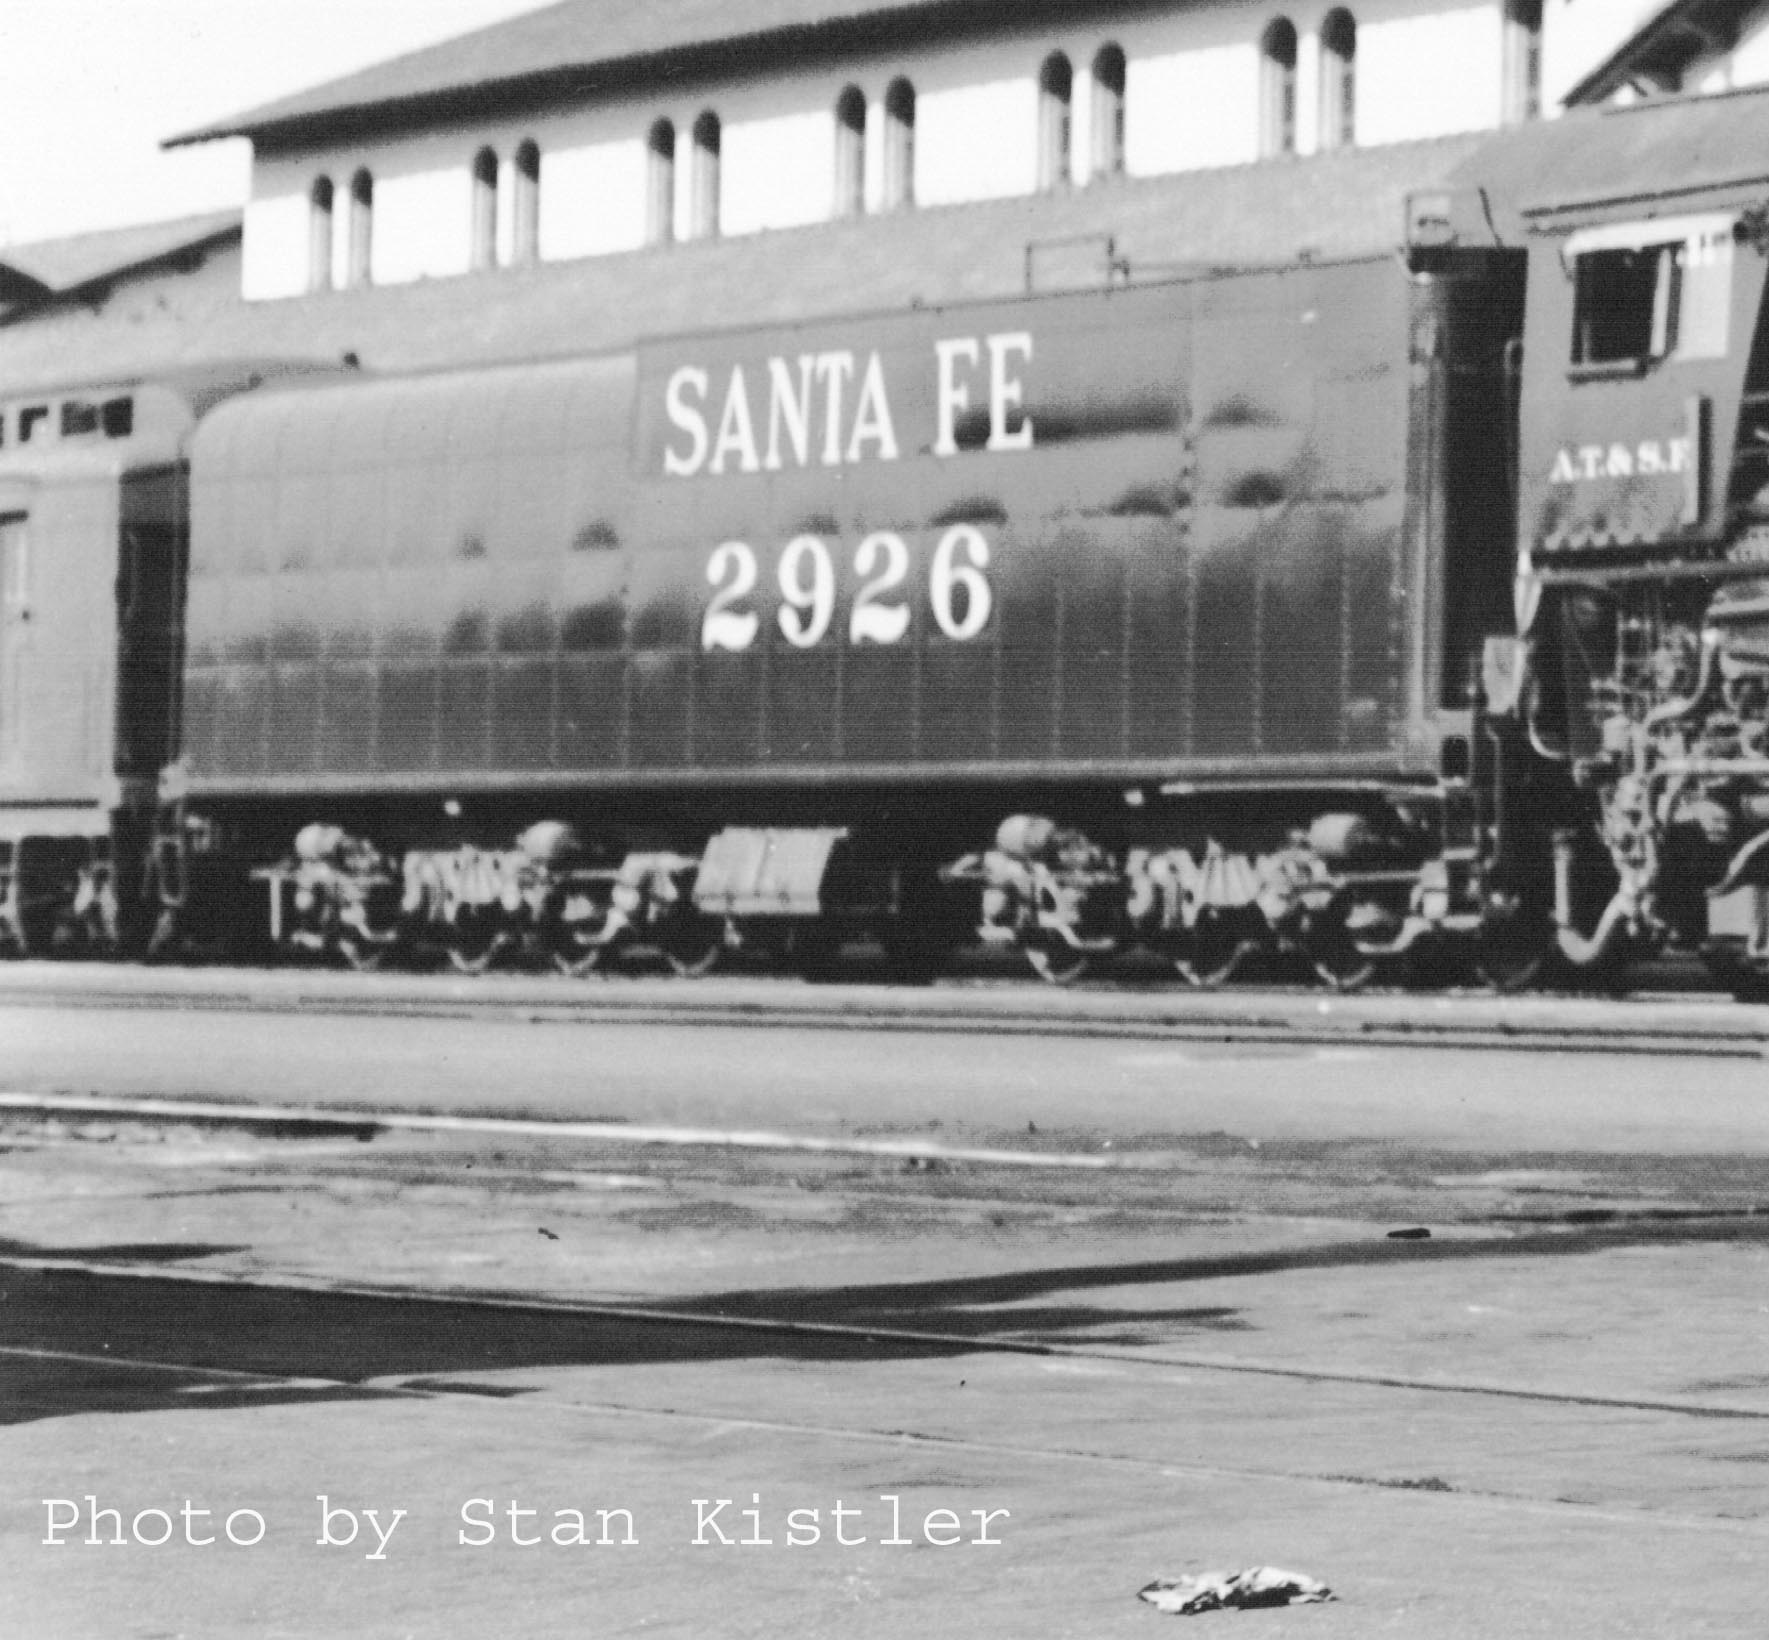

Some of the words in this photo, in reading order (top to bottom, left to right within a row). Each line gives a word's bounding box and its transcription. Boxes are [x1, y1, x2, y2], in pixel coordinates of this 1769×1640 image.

[663, 349, 899, 477] SANTA
[934, 331, 1034, 457] FE
[702, 524, 991, 651] 2926
